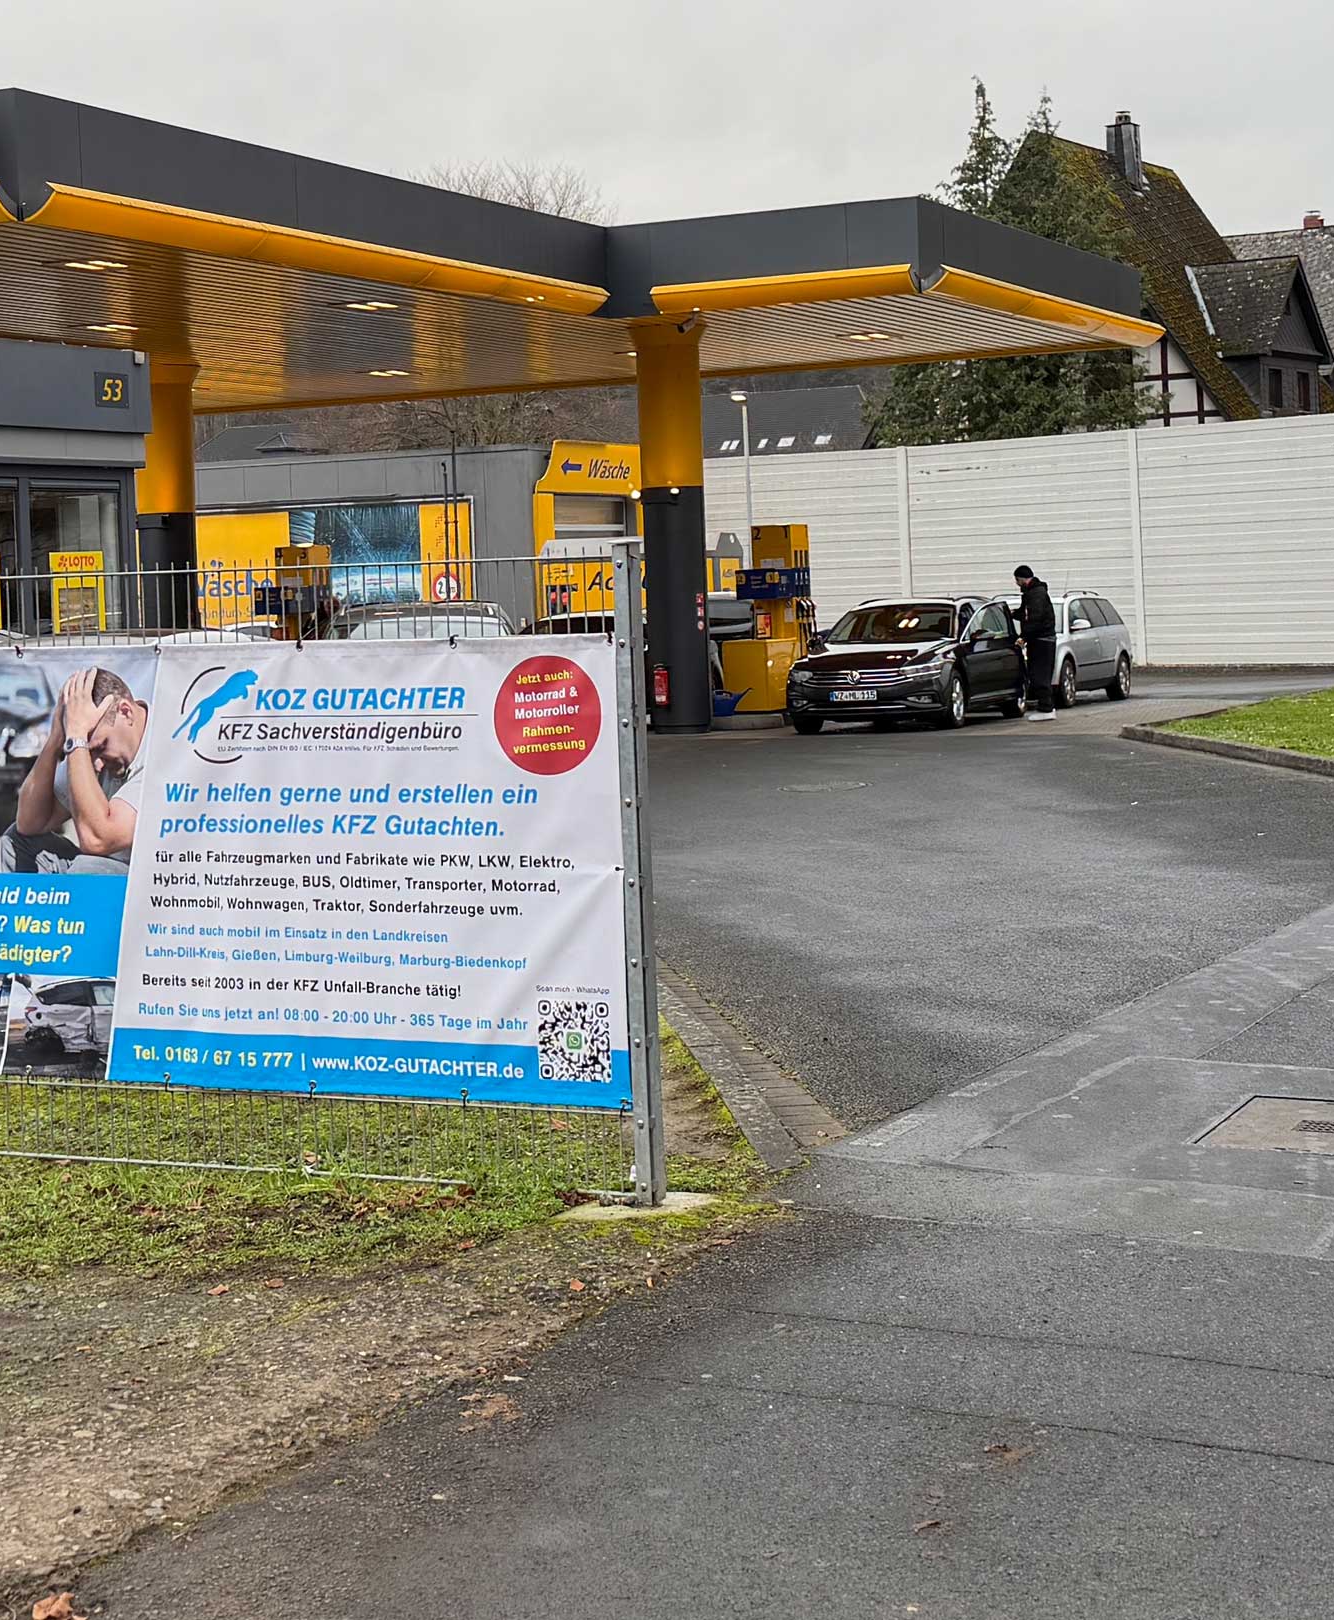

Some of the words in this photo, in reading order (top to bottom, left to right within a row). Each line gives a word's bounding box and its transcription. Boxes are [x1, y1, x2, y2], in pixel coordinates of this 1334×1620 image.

[102, 379, 123, 402] 53
[587, 459, 631, 481] Wäsche
[69, 555, 95, 567] LOTTO
[516, 674, 541, 685] Jetzt
[545, 670, 573, 682] auch:
[256, 688, 305, 711] KOZ
[313, 687, 465, 711] GUTACHTER
[514, 687, 566, 703] Motorrad
[569, 686, 578, 697] &
[514, 704, 580, 720] Motorroller
[218, 723, 253, 740] KFZ
[257, 720, 462, 744] Sachverständigenbüro
[522, 725, 575, 738] Rahmen-
[513, 739, 586, 754] vermessung
[166, 783, 199, 802] Wir
[207, 783, 271, 803] helfen
[280, 786, 341, 807] gerne
[349, 783, 391, 803] und
[398, 783, 493, 804] erstellen
[502, 784, 538, 804] ein
[159, 813, 324, 838] professionelles
[332, 814, 377, 835] KFZ
[385, 815, 505, 837] Gutachten.
[155, 851, 173, 863] für
[178, 851, 202, 863] alle
[206, 851, 311, 866] Fahrzeugmarken
[316, 853, 341, 865] und
[346, 853, 408, 866] Fabrikate
[413, 854, 435, 867] wie
[440, 855, 474, 869] PKW,
[478, 855, 514, 870] LKW,
[519, 856, 575, 871] Elektro,
[153, 873, 200, 888] Hybrid,
[204, 874, 298, 889] Nutzfahrzeuge,
[302, 876, 335, 889] BUS,
[339, 876, 401, 891] Oldtimer,
[405, 877, 486, 893] Transporter,
[491, 879, 561, 894] Motorrad,
[25, 888, 70, 905] beim
[150, 896, 223, 911] Wohnmobil,
[227, 898, 308, 913] Wohnwagen,
[313, 899, 364, 914] Traktor,
[369, 900, 485, 917] Sonderfahrzeuge
[490, 904, 523, 915] uvm.
[14, 916, 50, 934] Was
[57, 918, 85, 935] tun
[147, 924, 167, 935] Wir
[171, 924, 195, 935] sind
[199, 925, 224, 936] auch
[227, 926, 261, 938] mobil
[265, 927, 280, 938] im
[284, 927, 327, 940] Einsatz
[331, 928, 342, 939] in
[346, 929, 369, 941] den
[373, 929, 448, 943] Landkreisen
[145, 946, 229, 962] Lahn-Dill-Kreis,
[232, 950, 280, 962] Gießen,
[284, 950, 395, 967] Limburg-Weilburg,
[399, 953, 527, 971] Marburg-Biedenkopf
[142, 974, 187, 987] Bereits
[191, 976, 211, 988] seit
[214, 977, 244, 990] 2003
[249, 978, 261, 990] in
[267, 978, 289, 991] der
[293, 980, 319, 992] KFZ
[324, 980, 421, 996] Unfall-Branche
[426, 984, 461, 999] tätig!
[138, 1002, 174, 1016] Rufen
[179, 1004, 198, 1017] Sie
[202, 1008, 221, 1018] uns
[224, 1006, 253, 1021] jetzt
[257, 1008, 279, 1021] an!
[284, 1008, 319, 1022] 08:00
[332, 1010, 369, 1024] 20:00
[374, 1012, 396, 1025] Uhr
[410, 1014, 435, 1027] 365
[439, 1014, 472, 1031] Tage
[476, 1018, 492, 1030] im
[497, 1018, 528, 1031] Jahr
[133, 1045, 160, 1061] Tel.
[201, 1050, 209, 1064] /
[213, 1050, 232, 1066] 67
[238, 1052, 257, 1067] 15
[262, 1052, 293, 1068] 777
[312, 1056, 524, 1079] www.KOZ-GUTACHTER.de
